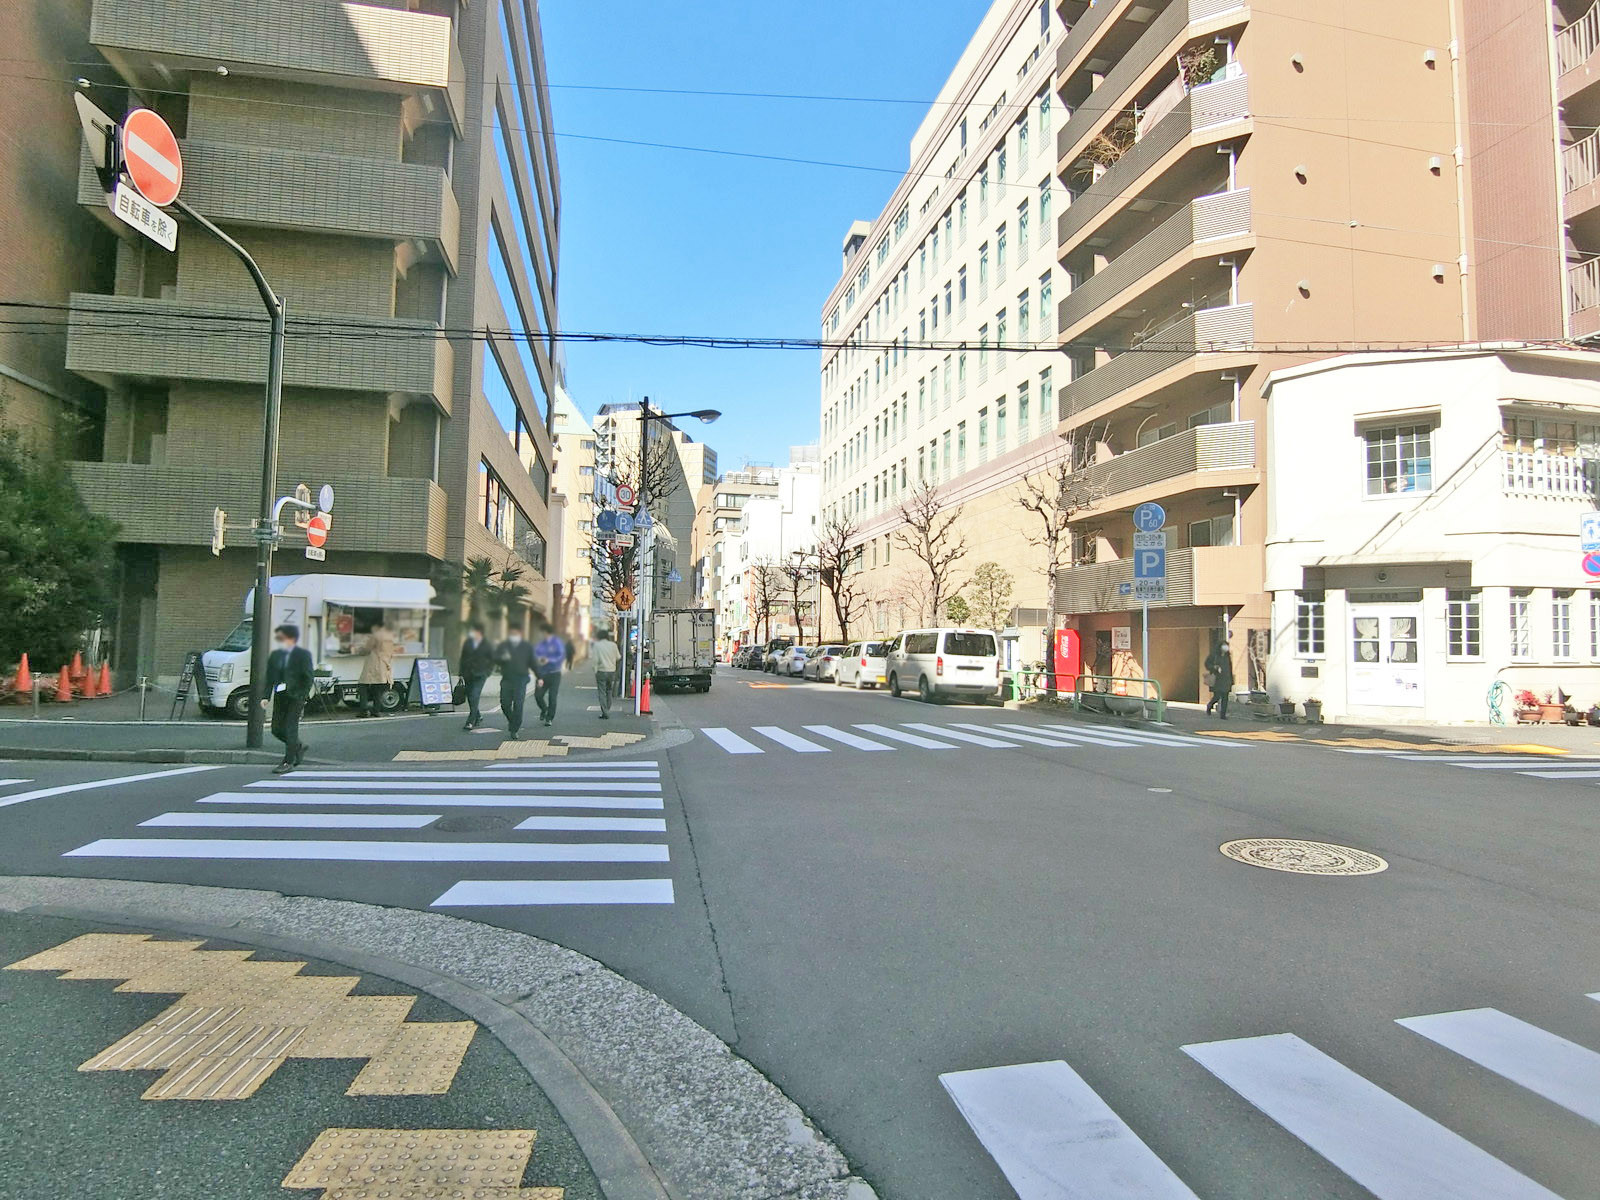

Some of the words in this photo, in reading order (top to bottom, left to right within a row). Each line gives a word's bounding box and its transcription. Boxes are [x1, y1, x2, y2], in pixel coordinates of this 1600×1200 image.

[119, 193, 172, 244] 自転車を除く
[621, 490, 631, 500] 30
[1140, 510, 1152, 528] P
[1149, 519, 1158, 528] 60
[1142, 552, 1160, 576] P
